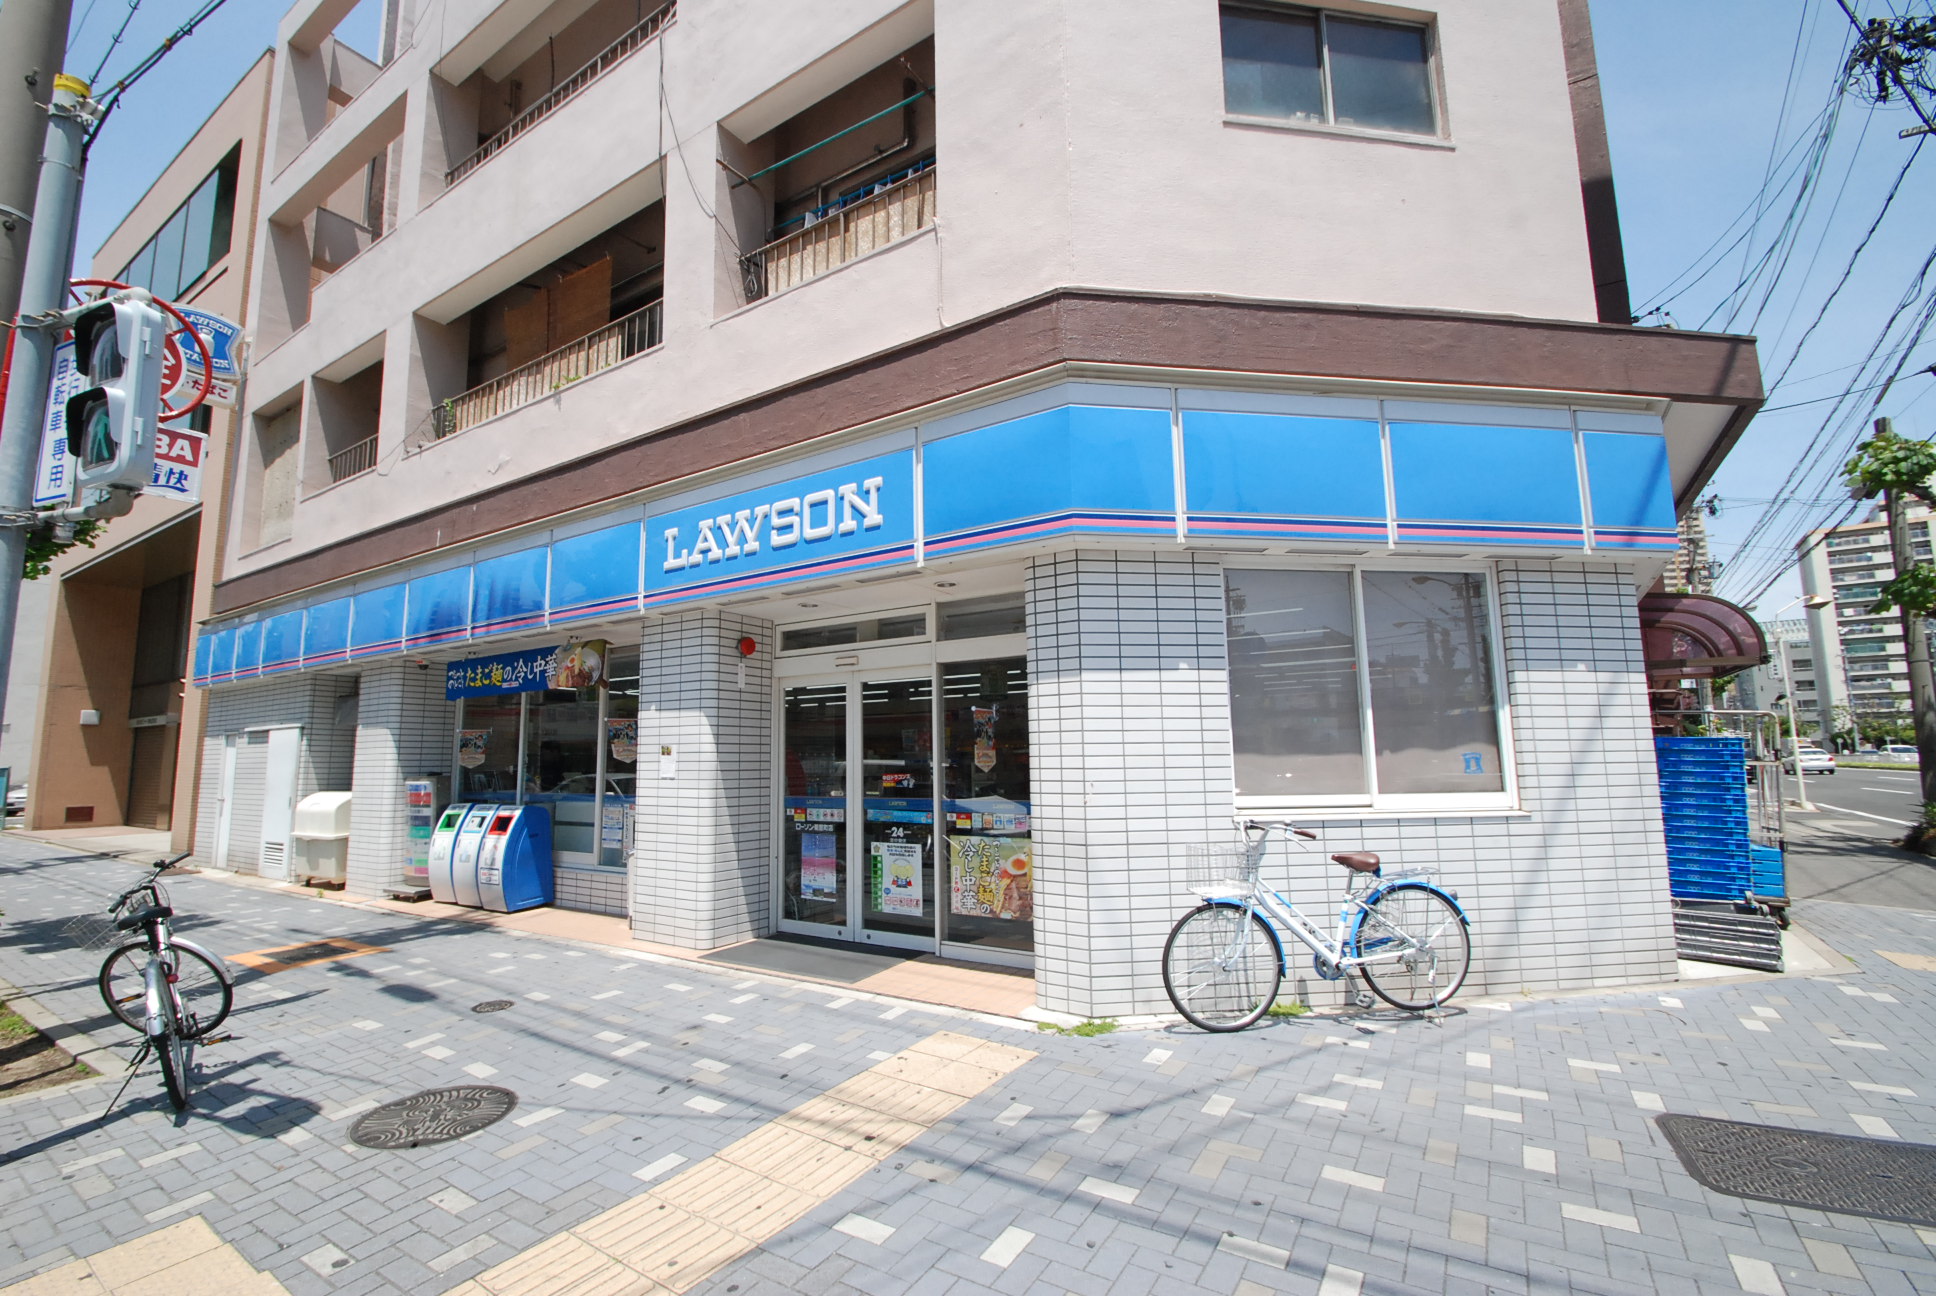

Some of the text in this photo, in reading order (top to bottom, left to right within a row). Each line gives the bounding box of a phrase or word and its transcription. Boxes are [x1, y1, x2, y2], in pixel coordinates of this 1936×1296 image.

[155, 433, 194, 462] BA
[664, 476, 883, 570] LAWSON
[957, 838, 978, 913] 冷し中華
